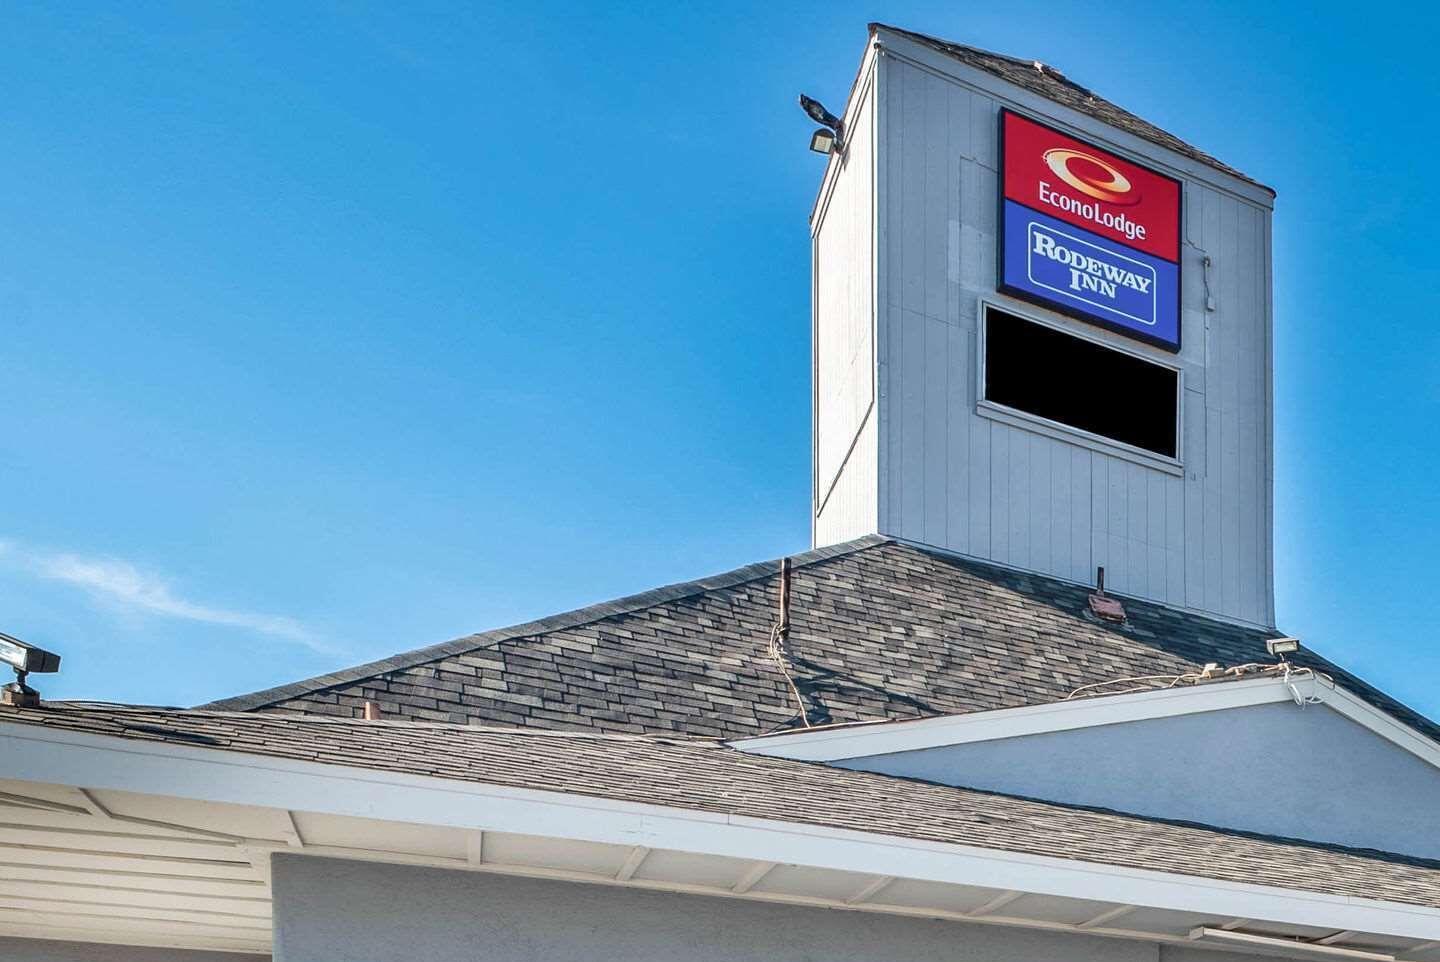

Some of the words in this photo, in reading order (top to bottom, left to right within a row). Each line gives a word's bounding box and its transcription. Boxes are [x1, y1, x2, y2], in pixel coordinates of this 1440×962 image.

[1039, 181, 1146, 240] EconoLodge
[1033, 231, 1152, 294] RODEWAY
[1069, 268, 1116, 299] INN
